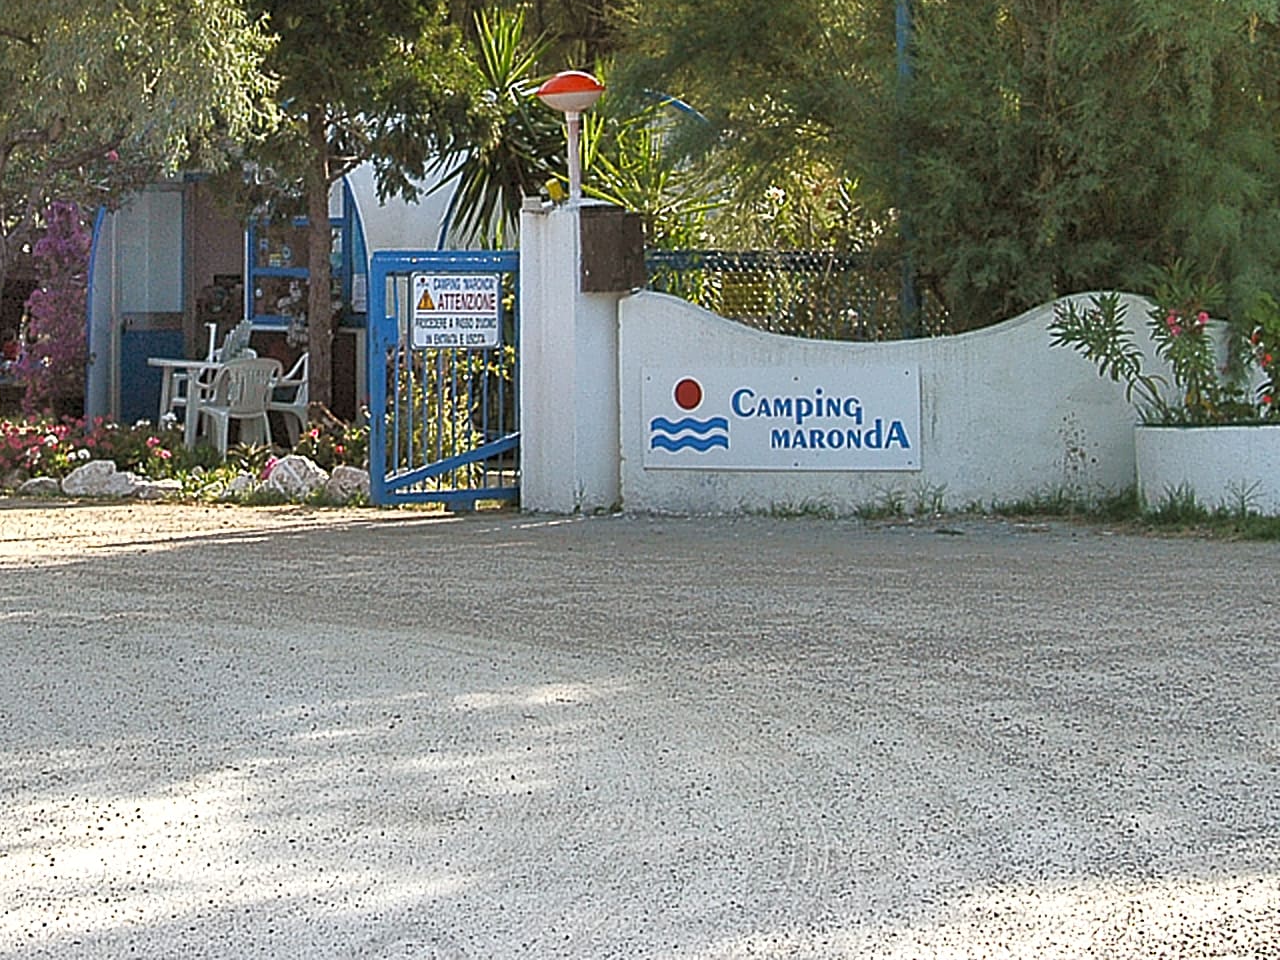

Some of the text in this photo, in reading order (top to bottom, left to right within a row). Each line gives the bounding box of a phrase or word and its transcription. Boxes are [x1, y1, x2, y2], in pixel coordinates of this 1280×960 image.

[438, 293, 495, 310] ATTENZIONE
[415, 318, 447, 329] PROCEDERE
[455, 318, 473, 329] PASSO
[434, 333, 458, 345] ENTRATA
[466, 333, 486, 345] USCITA
